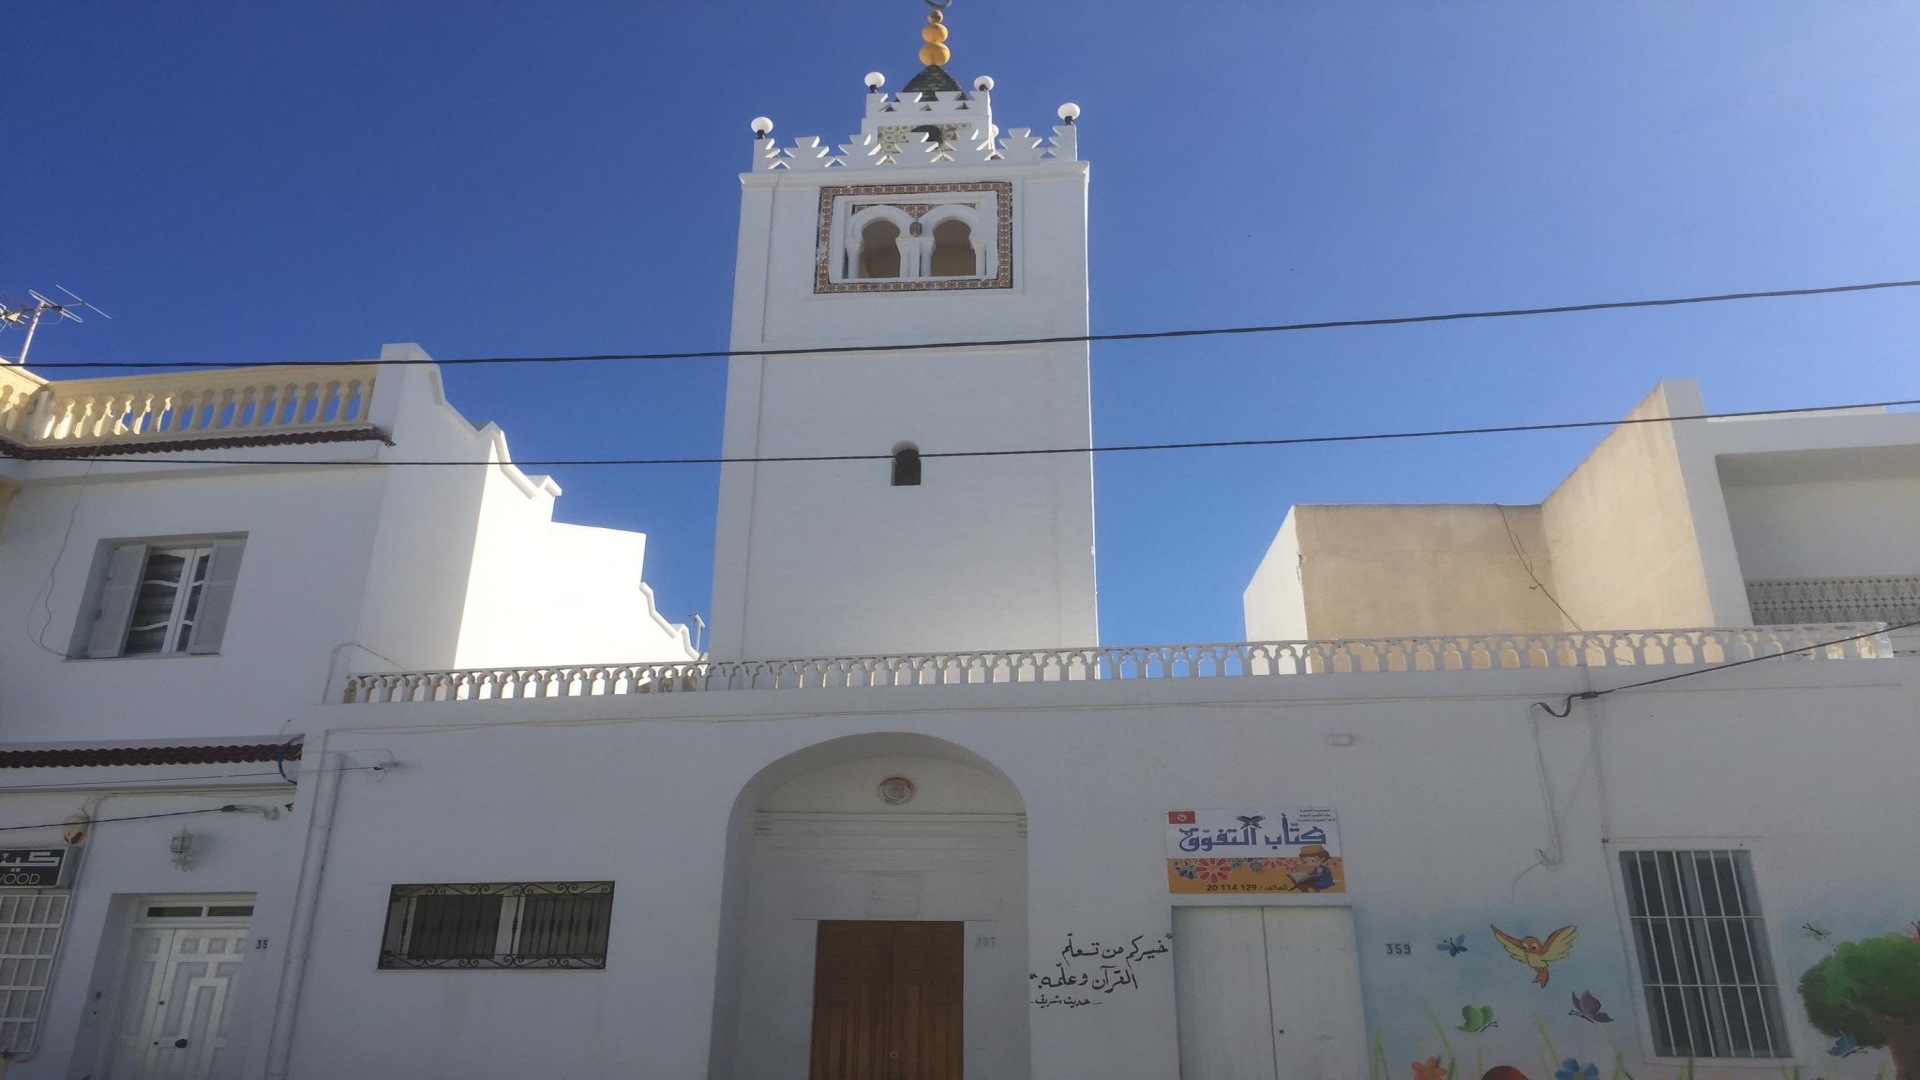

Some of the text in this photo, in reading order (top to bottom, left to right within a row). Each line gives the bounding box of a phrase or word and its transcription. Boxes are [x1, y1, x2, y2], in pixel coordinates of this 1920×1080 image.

[0, 873, 40, 885] OOD
[1206, 884, 1218, 892] 20
[255, 939, 269, 950] 35
[1385, 943, 1411, 955] 359
